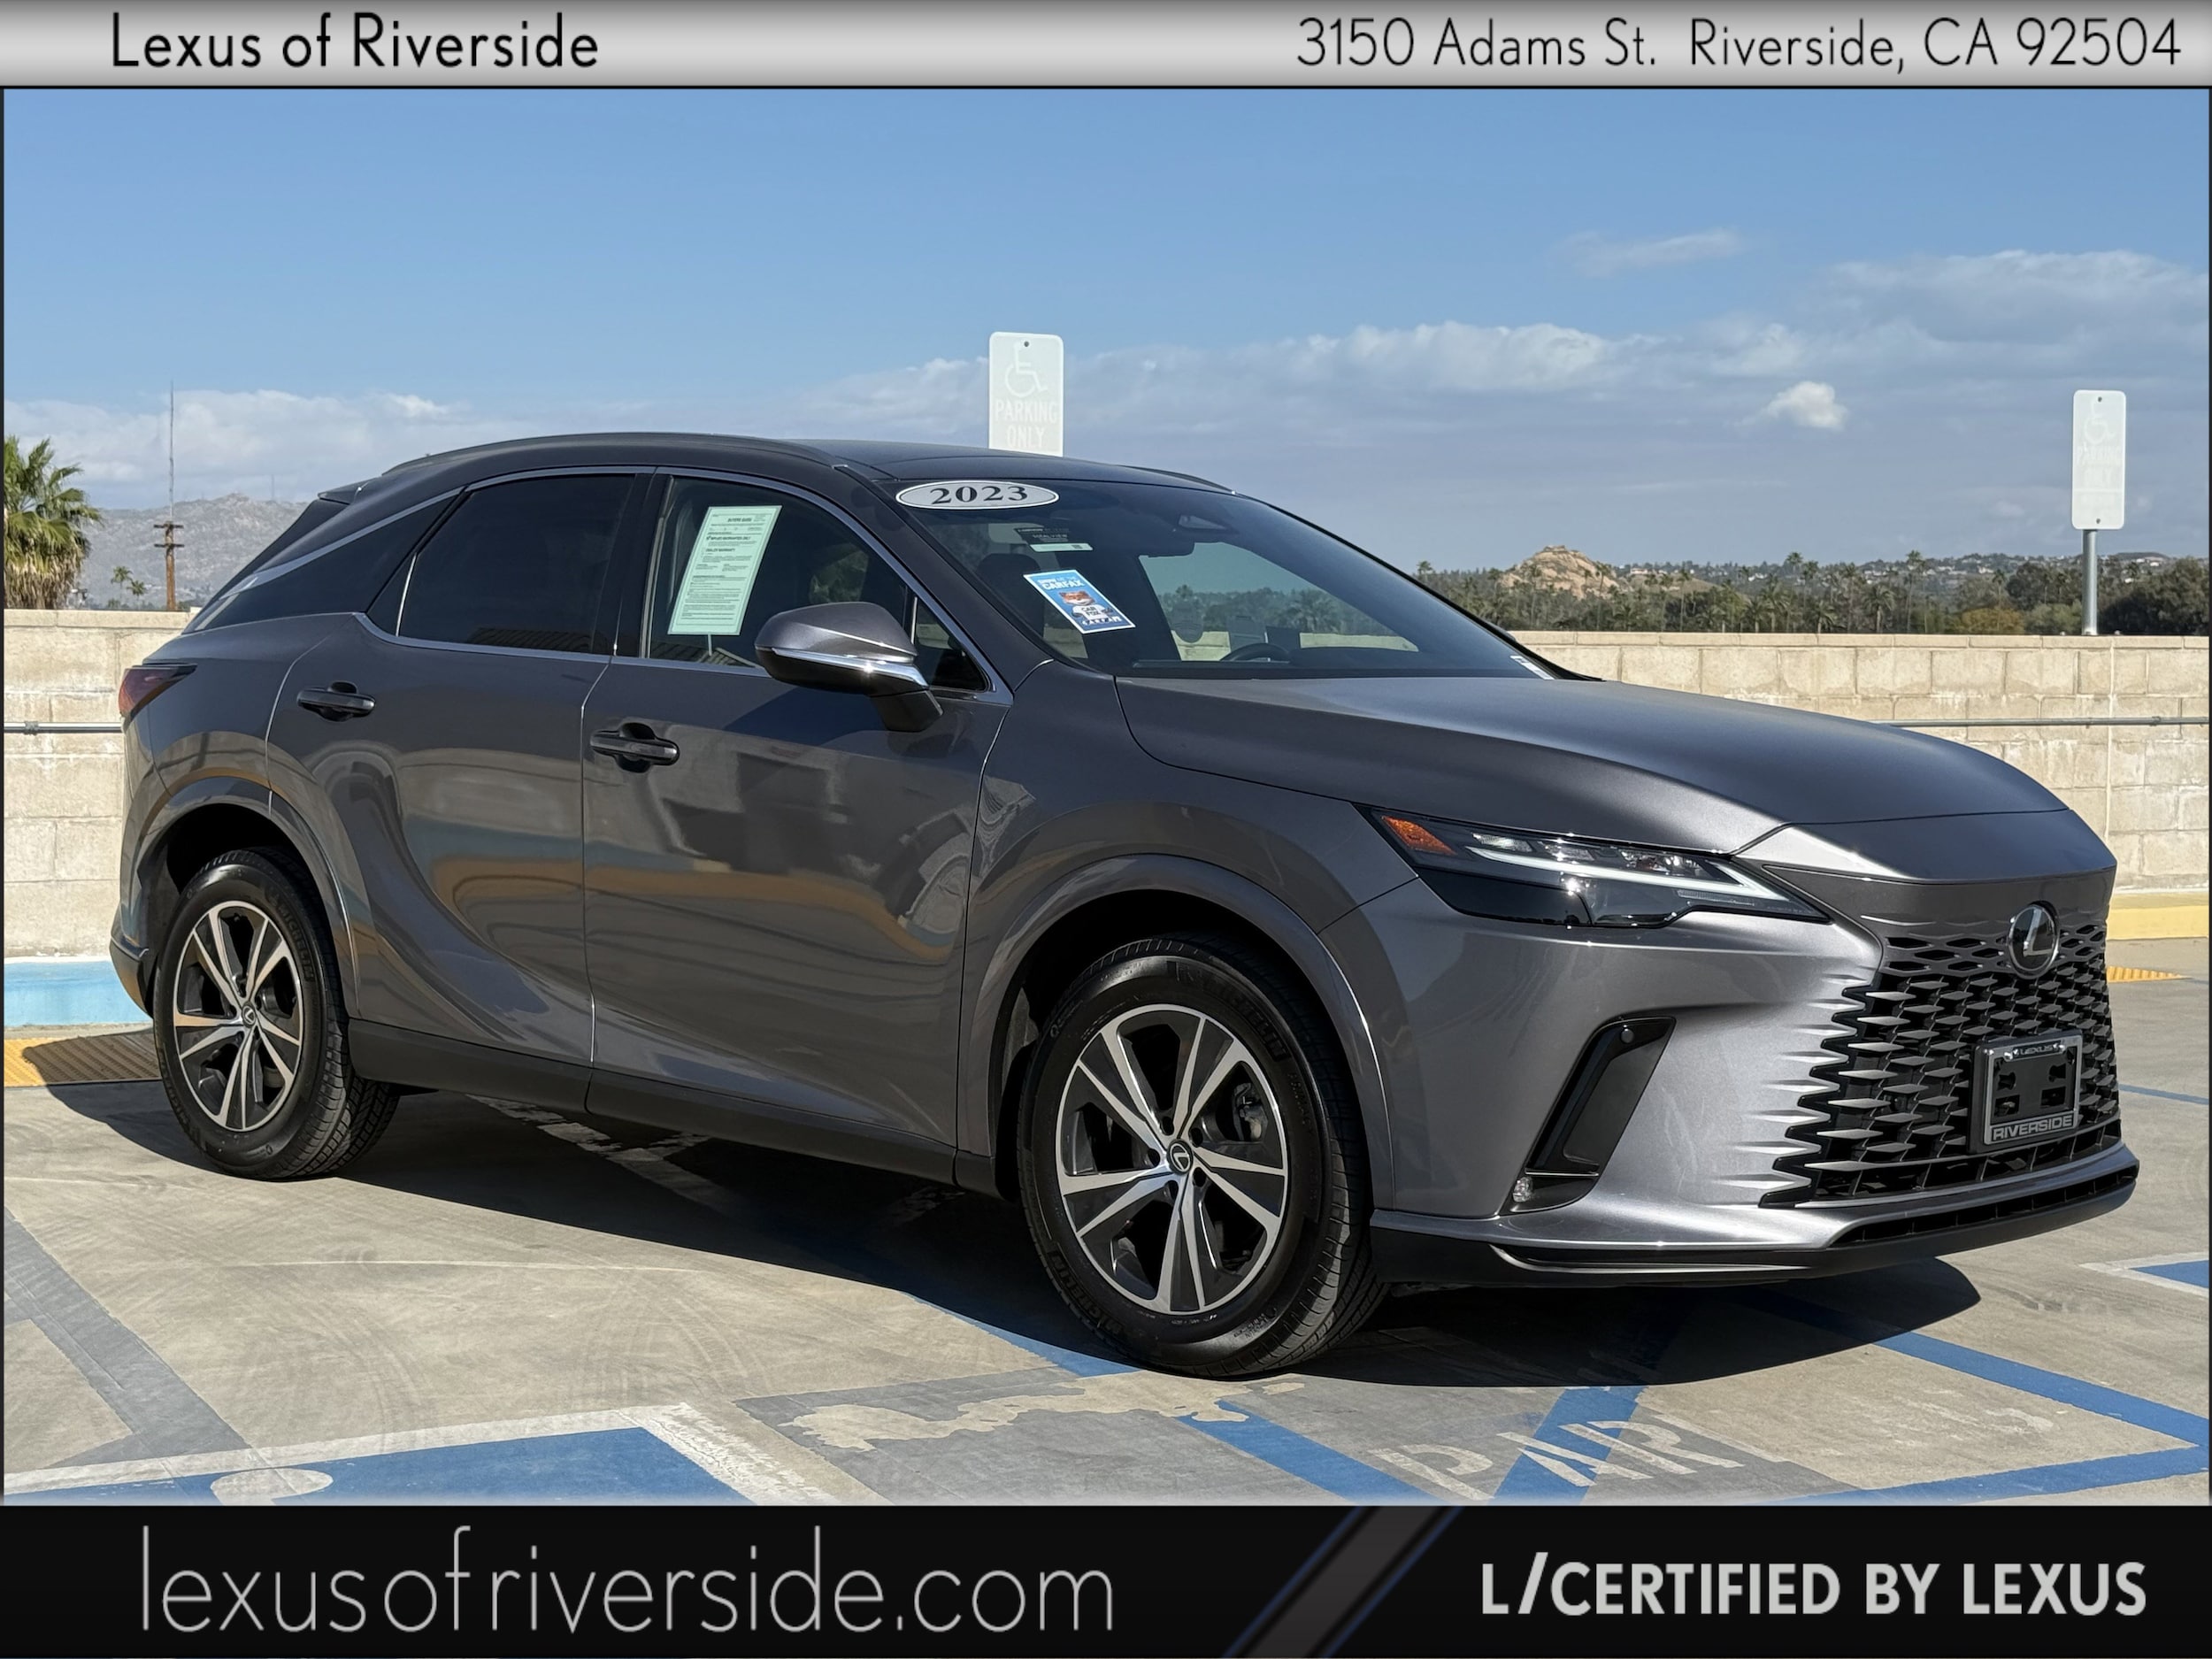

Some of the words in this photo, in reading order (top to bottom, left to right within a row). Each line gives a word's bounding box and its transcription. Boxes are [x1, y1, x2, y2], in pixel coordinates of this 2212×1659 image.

[995, 399, 1057, 424] PARKING
[1006, 425, 1045, 448] ONLY
[930, 486, 1028, 504] 2023
[1041, 580, 1085, 590] CARFAX
[2020, 1045, 2053, 1056] LEXUS
[1993, 1116, 2072, 1141] RIVERSIDE
